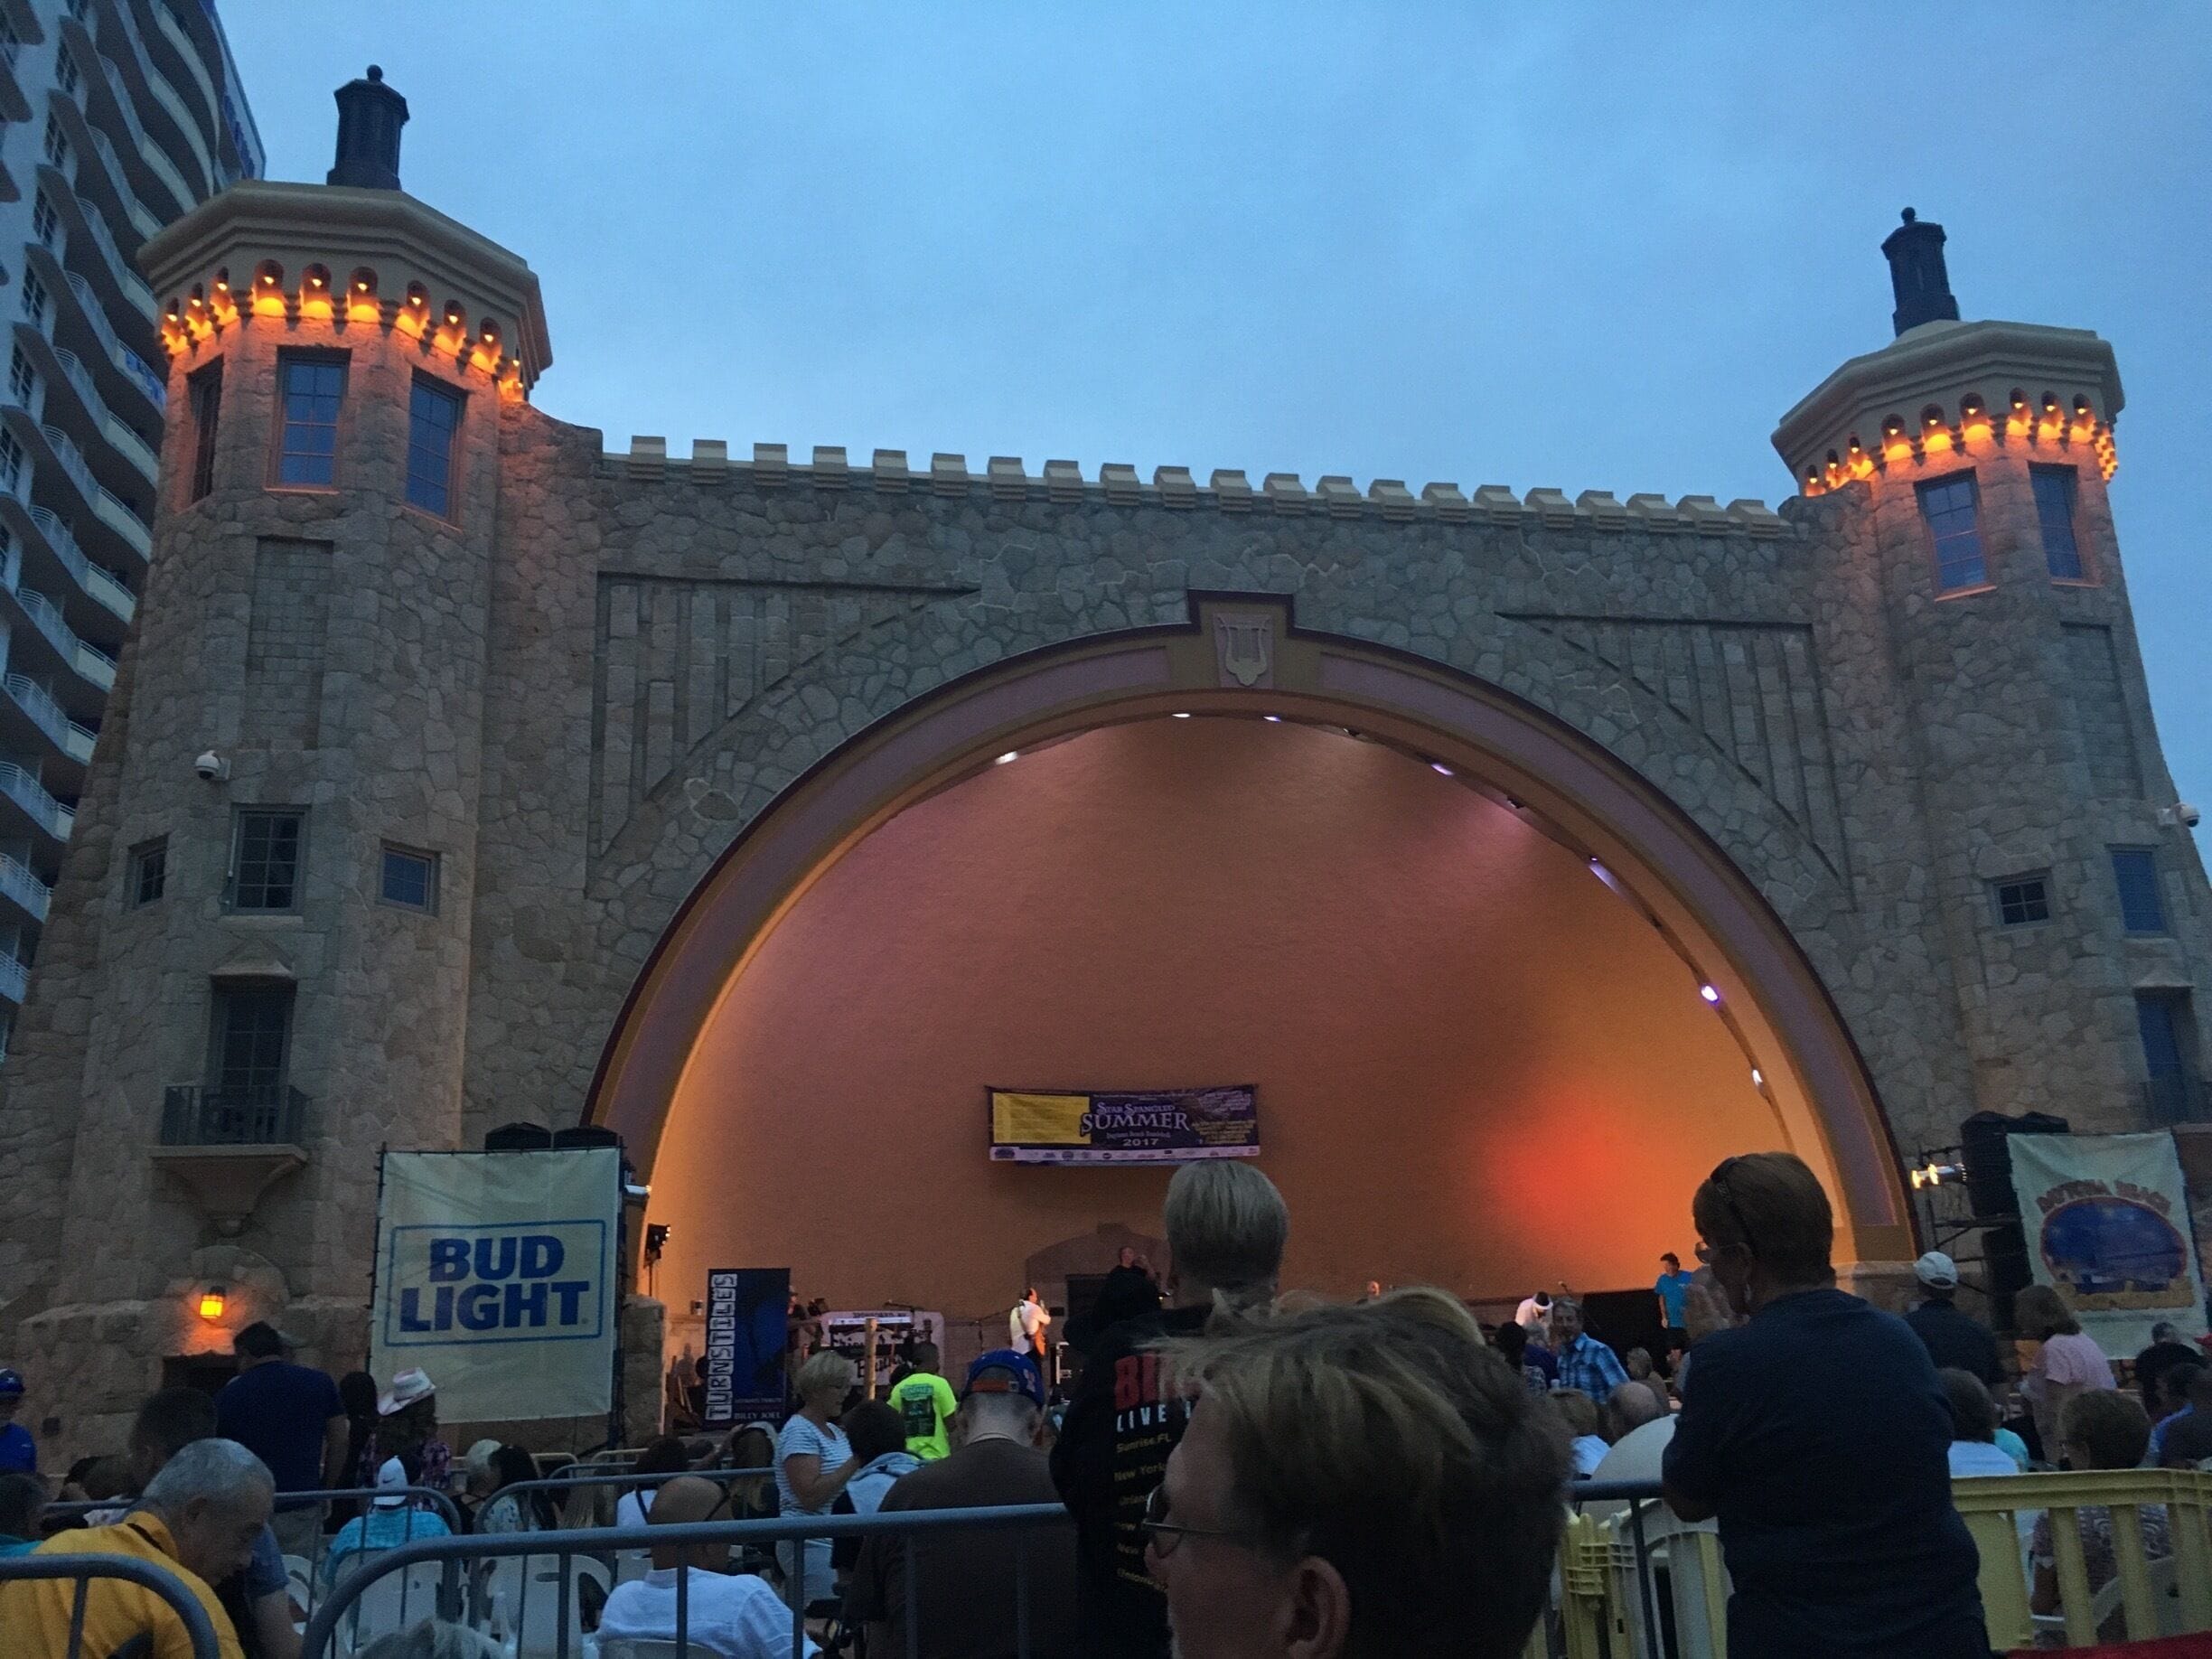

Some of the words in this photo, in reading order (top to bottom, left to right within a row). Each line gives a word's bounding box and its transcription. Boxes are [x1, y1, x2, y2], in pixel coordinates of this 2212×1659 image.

[1082, 1111, 1190, 1133] SUMMER
[1123, 1138, 1158, 1147] 2017
[428, 1234, 565, 1282] BUD
[399, 1280, 589, 1332] LIGHT
[708, 1274, 736, 1420] TURNSTILES
[1116, 1404, 1167, 1433] LIVE
